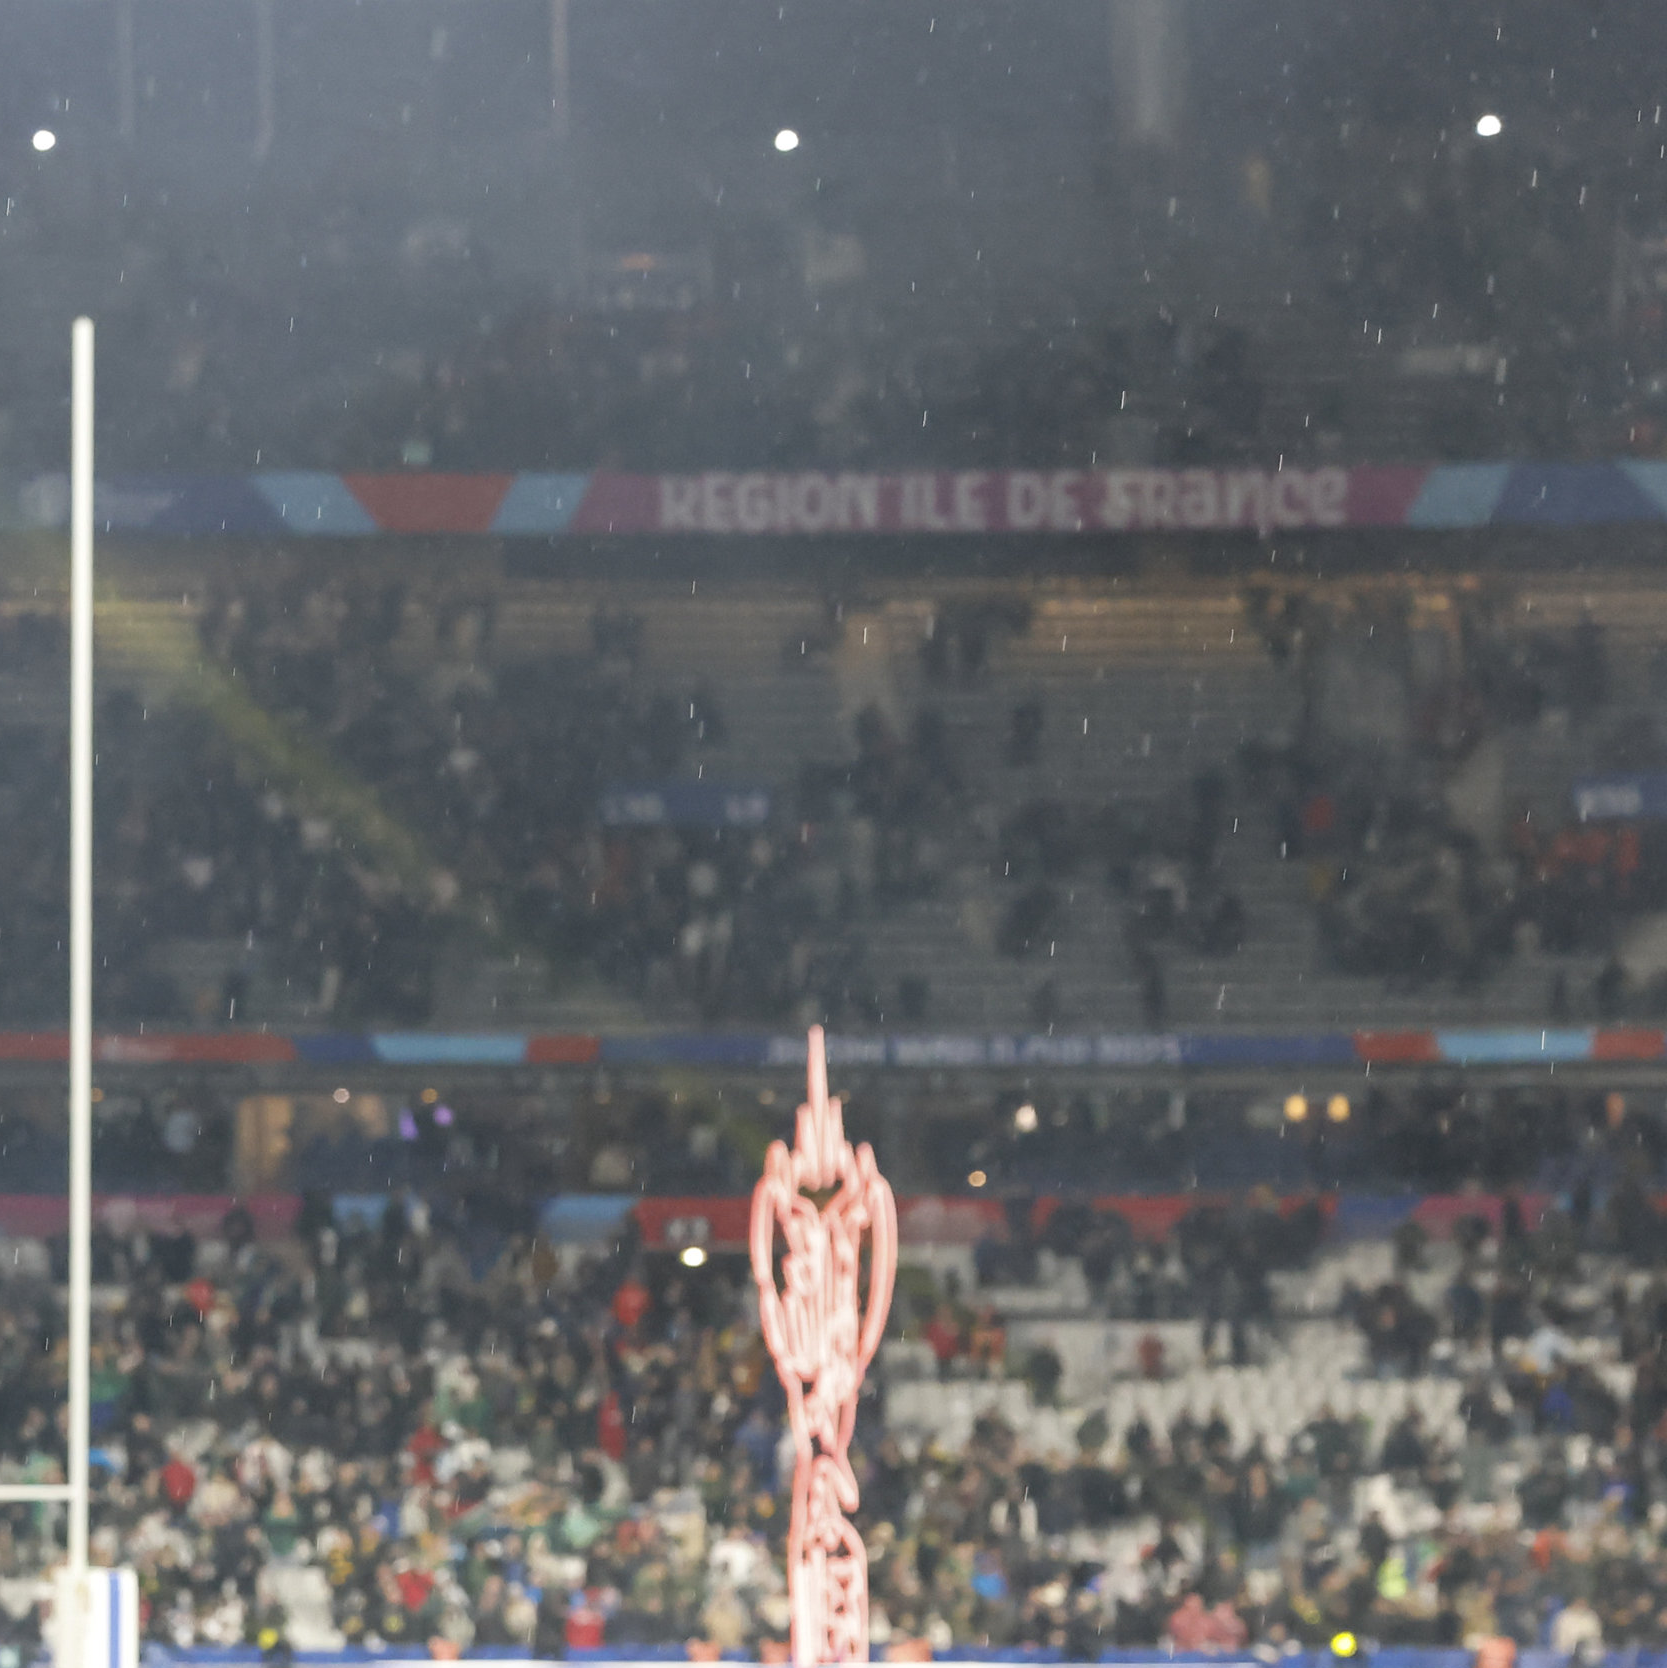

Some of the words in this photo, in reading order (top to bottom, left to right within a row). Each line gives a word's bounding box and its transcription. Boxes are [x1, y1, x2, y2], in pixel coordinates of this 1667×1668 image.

[659, 473, 879, 530] REGION
[901, 471, 990, 528] ILE
[1006, 470, 1078, 527] DE
